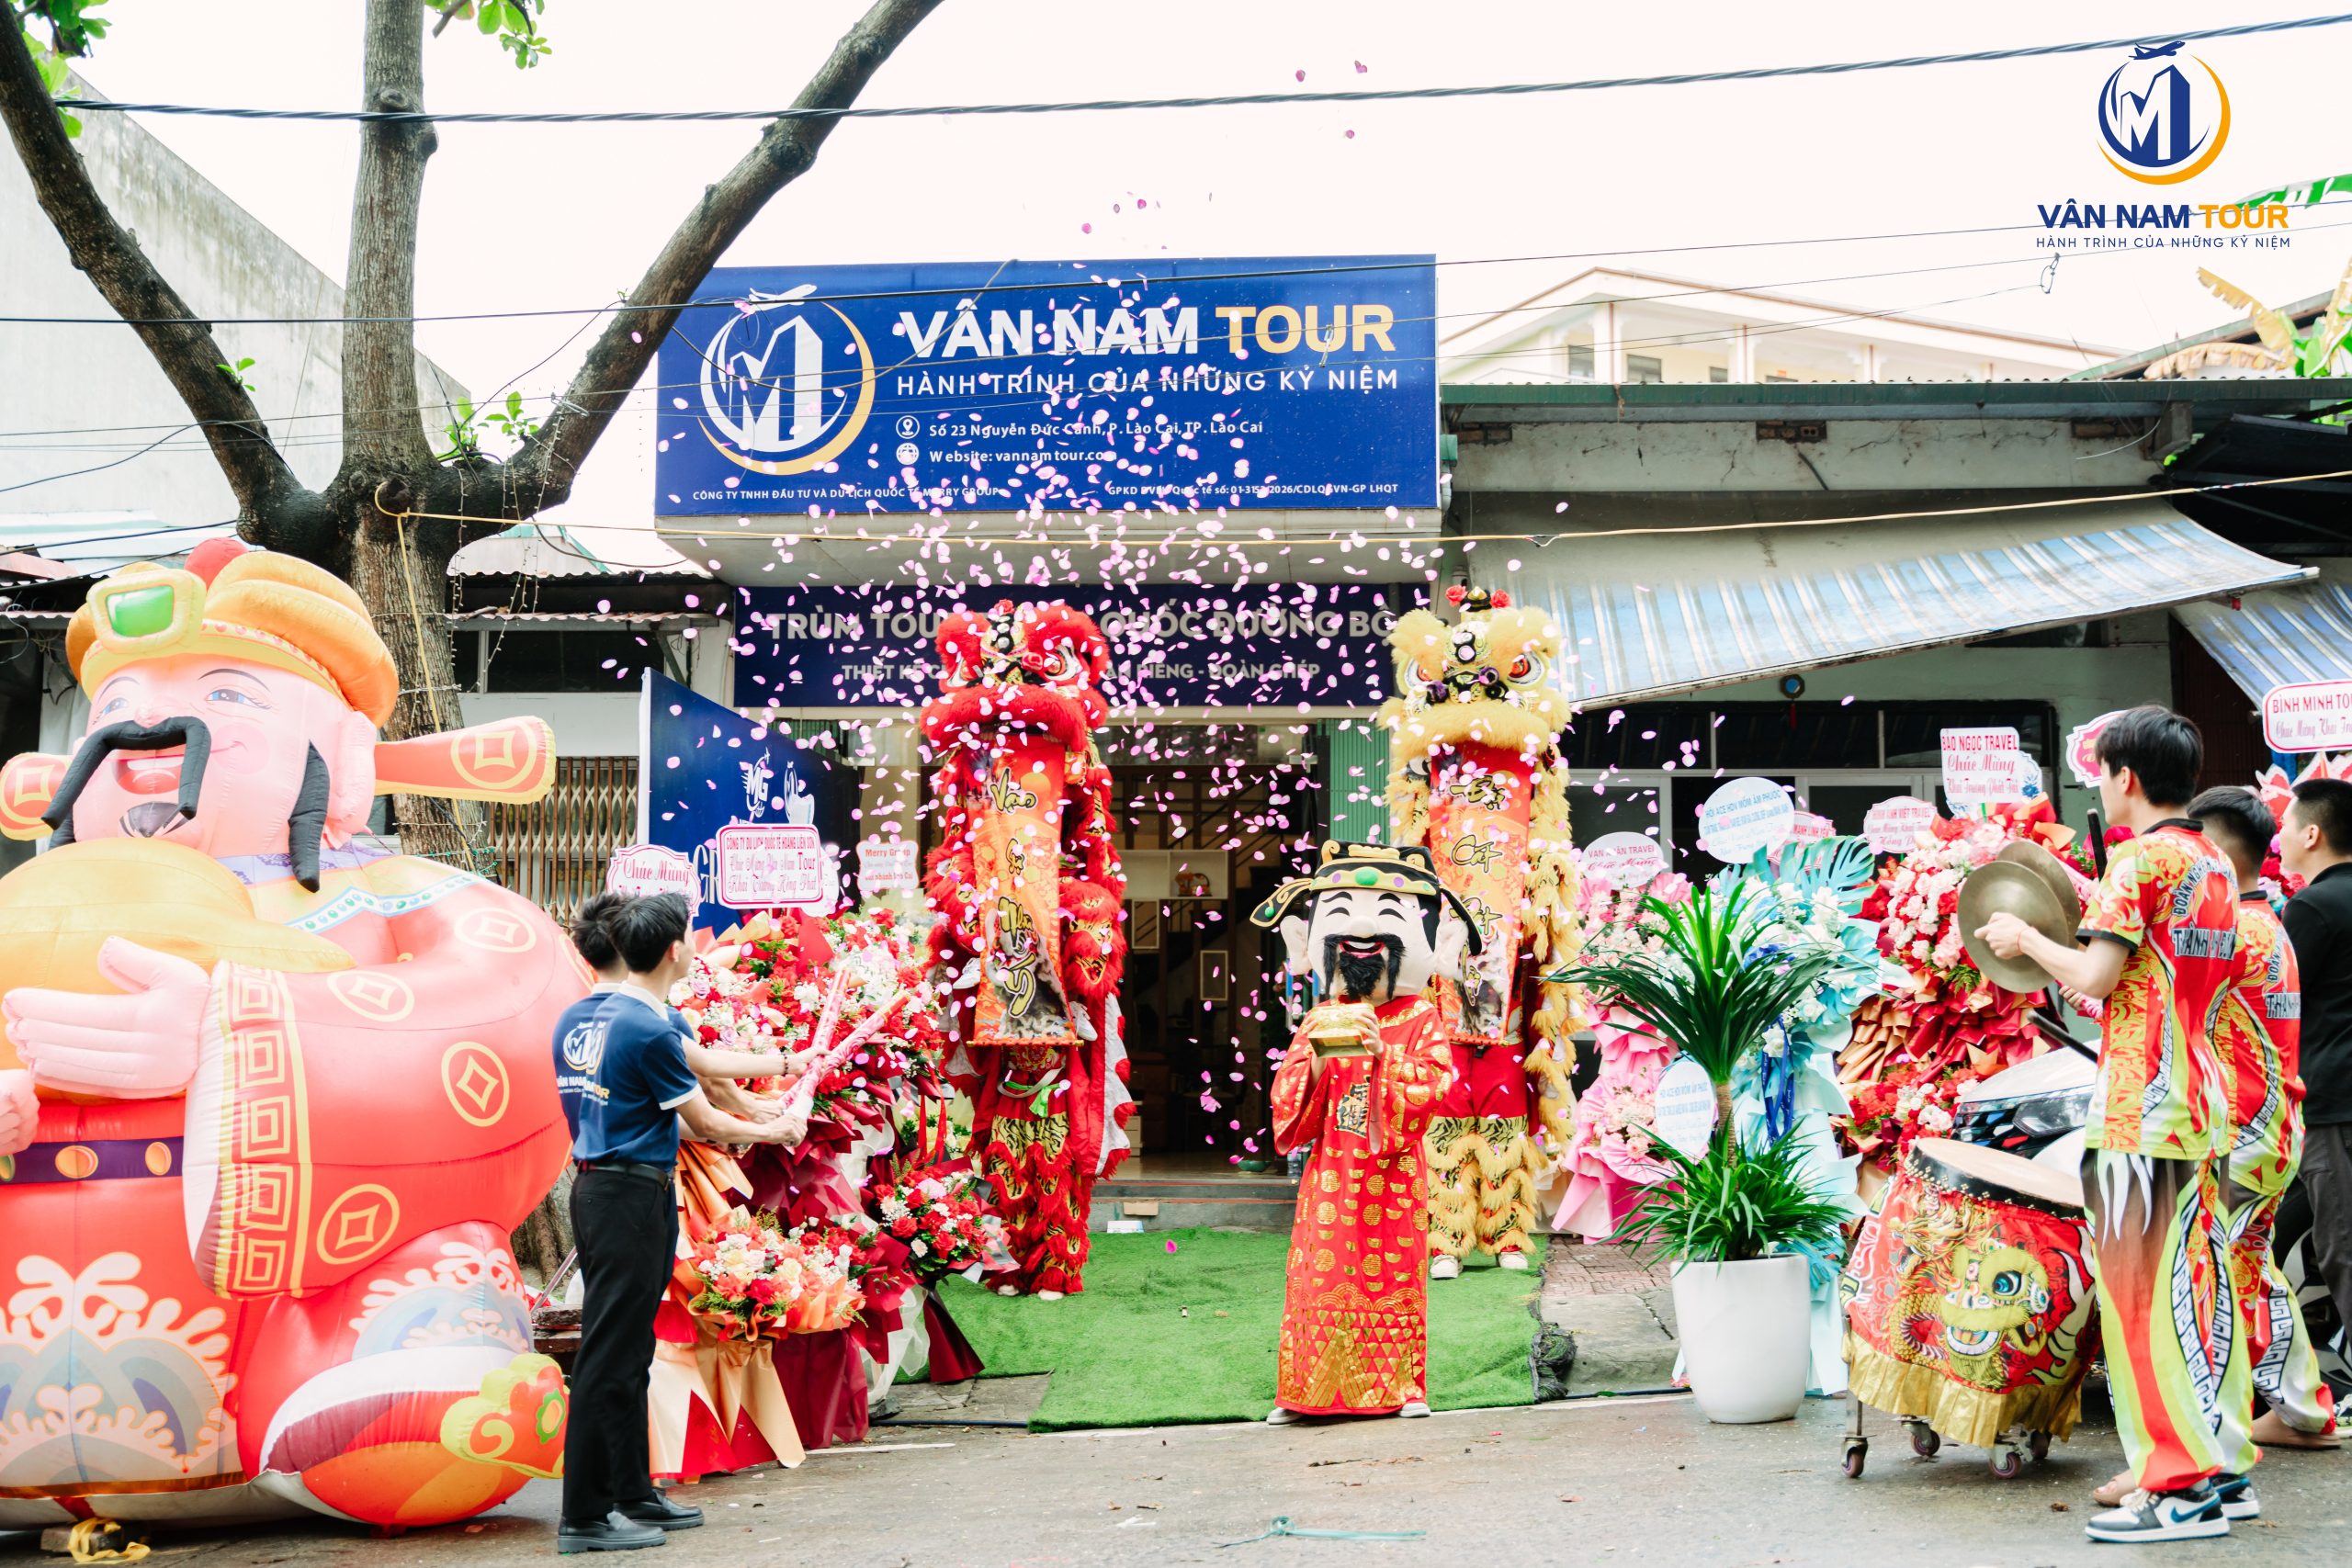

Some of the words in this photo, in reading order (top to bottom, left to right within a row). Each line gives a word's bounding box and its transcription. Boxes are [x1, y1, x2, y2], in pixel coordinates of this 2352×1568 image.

[899, 299, 1033, 358] VÂN
[1054, 307, 1198, 356] NAM
[1216, 304, 1396, 355] TOUR
[898, 370, 976, 396] HÀNH
[990, 367, 1074, 394] TRÌNH
[1088, 367, 1148, 393] CỦA
[1161, 367, 1266, 393] NHỮNG
[1280, 365, 1315, 391] KỶ
[1329, 365, 1397, 395] NIỆM
[929, 423, 947, 437] Số
[951, 425, 967, 436] 23
[970, 423, 1026, 439] Nguyễn
[1031, 423, 1060, 436] Đức
[1126, 423, 1151, 434] Lào
[1210, 422, 1236, 434] Lào
[1239, 422, 1263, 434] Cai
[693, 491, 723, 501] CÔNG
[726, 491, 738, 500] TY
[741, 491, 769, 500] TNHH
[797, 489, 811, 499] TƯ
[813, 488, 827, 498] VÀ
[830, 489, 845, 498] DU
[848, 489, 872, 499] LỊCH
[874, 486, 905, 498] QUỐC
[922, 488, 959, 497] MRRY
[1202, 484, 1213, 494] tế
[1215, 484, 1229, 494] số:
[1369, 483, 1399, 493] LHQT
[765, 604, 862, 640] TRÙM
[870, 611, 957, 639] TOU
[1208, 602, 1340, 638] ĐƯỜNG
[842, 658, 895, 680] THIẾT
[2272, 694, 2300, 714] BÌNH
[2302, 695, 2334, 712] MINH
[1959, 735, 1982, 754] NGỌC
[1984, 734, 2018, 750] TRAVEL
